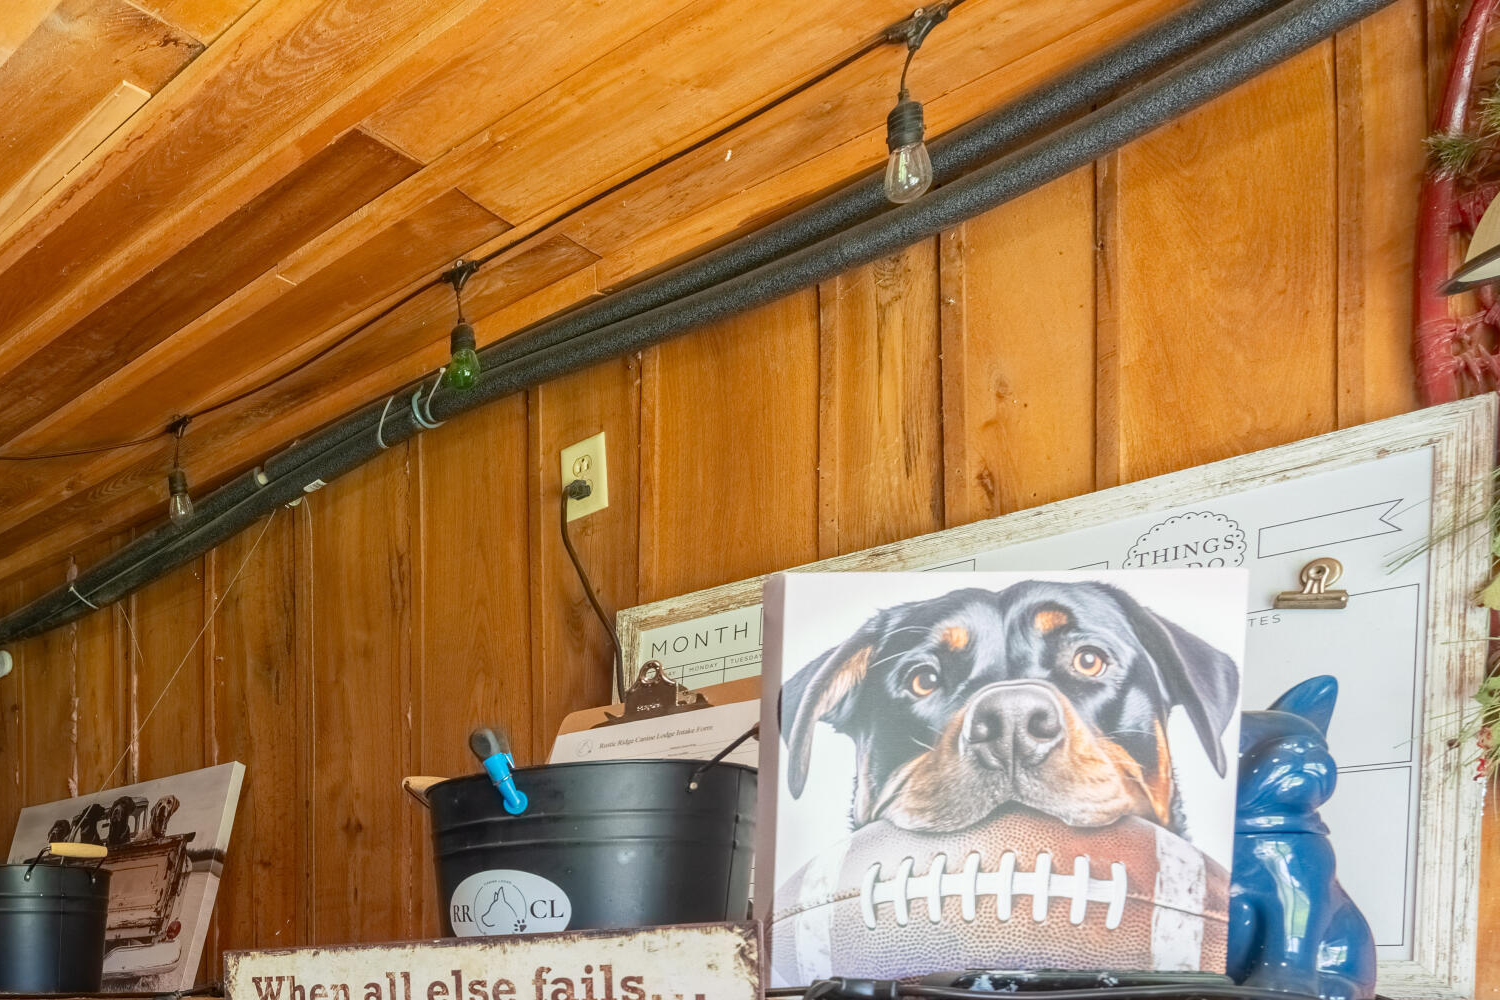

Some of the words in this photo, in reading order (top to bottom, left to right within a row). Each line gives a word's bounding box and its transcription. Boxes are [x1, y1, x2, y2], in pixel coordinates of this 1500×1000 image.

[1134, 534, 1235, 568] THINGS
[1248, 614, 1281, 628] TES
[651, 622, 748, 659] MONTH
[688, 662, 718, 673] MONDAY
[453, 904, 473, 922] RR
[530, 899, 565, 919] CL
